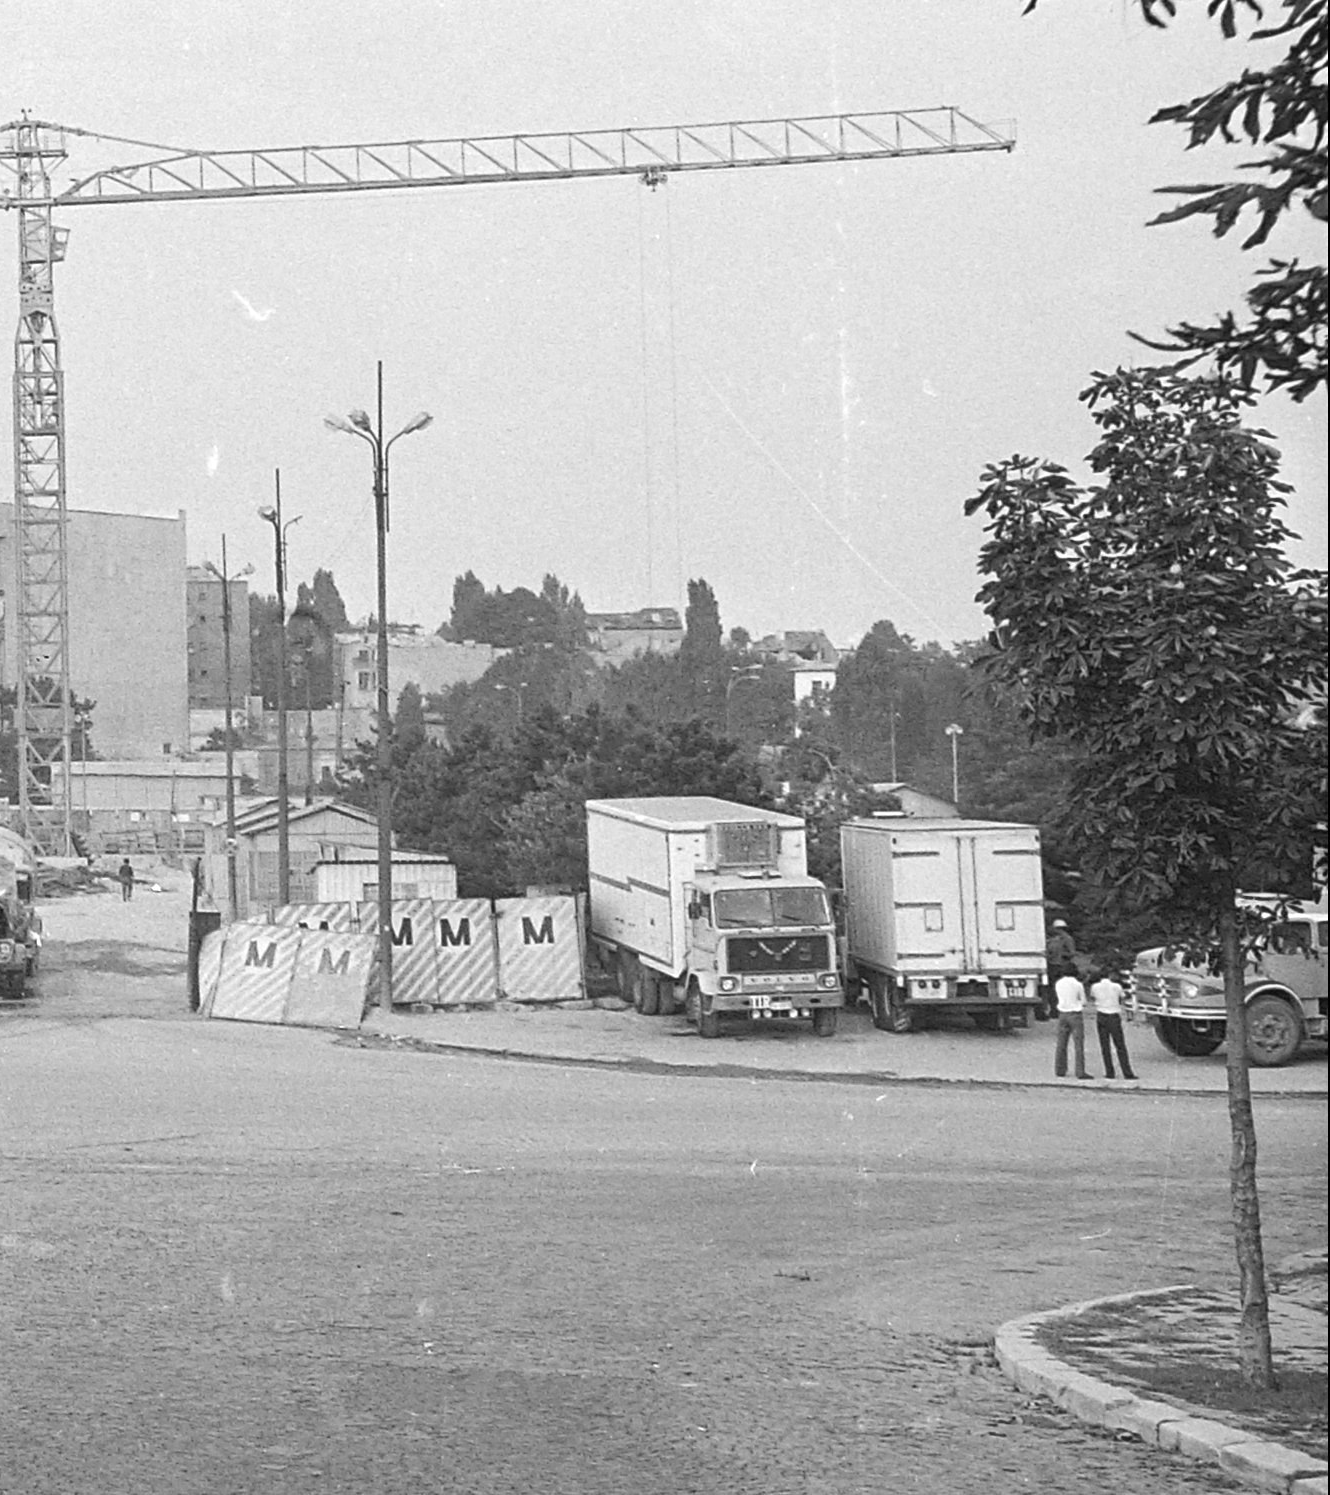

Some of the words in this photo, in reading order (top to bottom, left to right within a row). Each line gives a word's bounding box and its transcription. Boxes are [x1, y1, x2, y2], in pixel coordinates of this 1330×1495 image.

[440, 918, 471, 947] M
[523, 916, 555, 945] M
[245, 941, 277, 968] M
[317, 948, 350, 974] M
